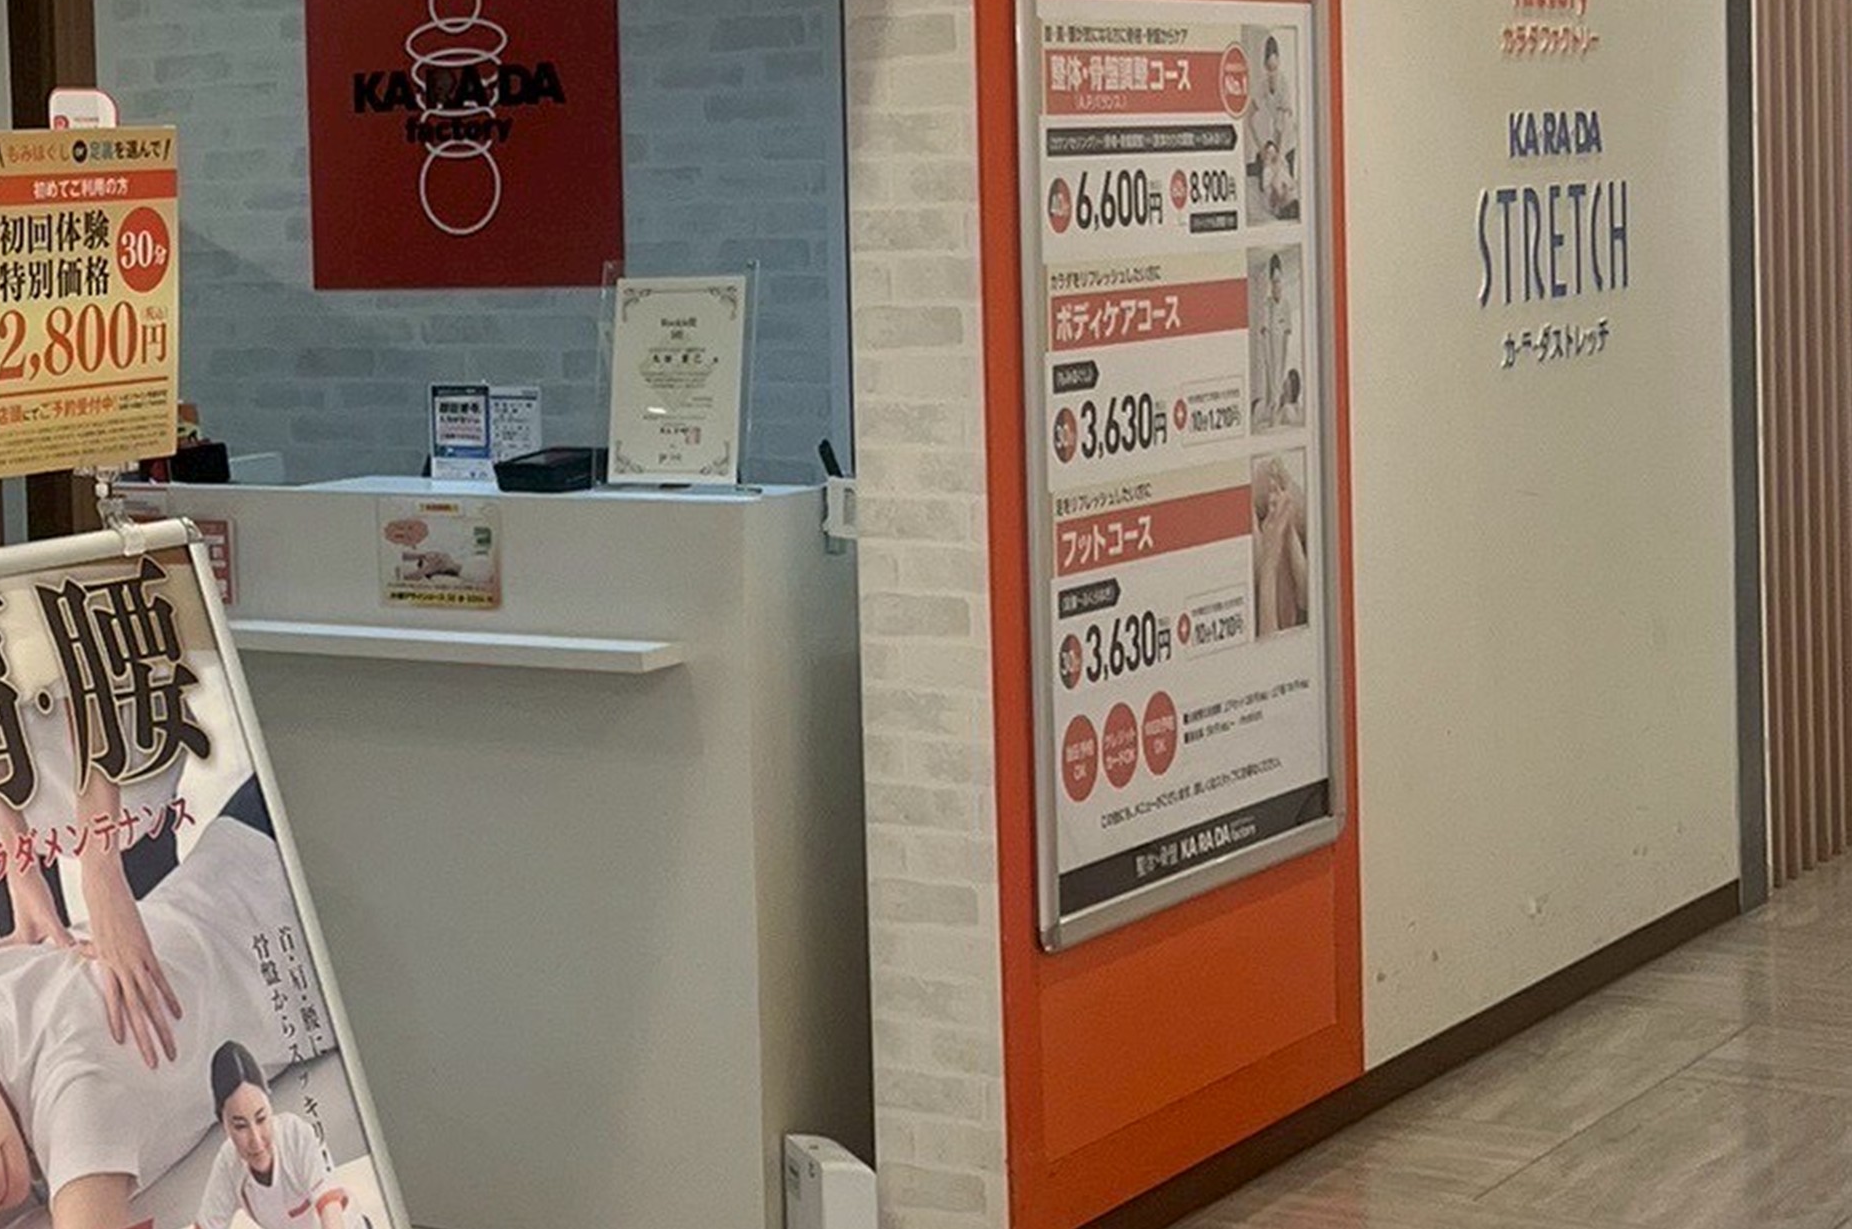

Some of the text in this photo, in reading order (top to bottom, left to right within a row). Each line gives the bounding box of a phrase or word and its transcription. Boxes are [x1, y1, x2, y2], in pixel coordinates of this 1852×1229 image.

[1076, 169, 1163, 232] 6,600円
[0, 209, 110, 256] 初回体験
[120, 230, 167, 270] 30分
[1477, 180, 1629, 308] STRETCH
[0, 256, 110, 303] 特別価格
[1055, 295, 1181, 342] ボディケアコース
[1080, 392, 1168, 460] 3,630円
[1061, 514, 1154, 568] フットコース
[1086, 610, 1172, 682] 3,630円
